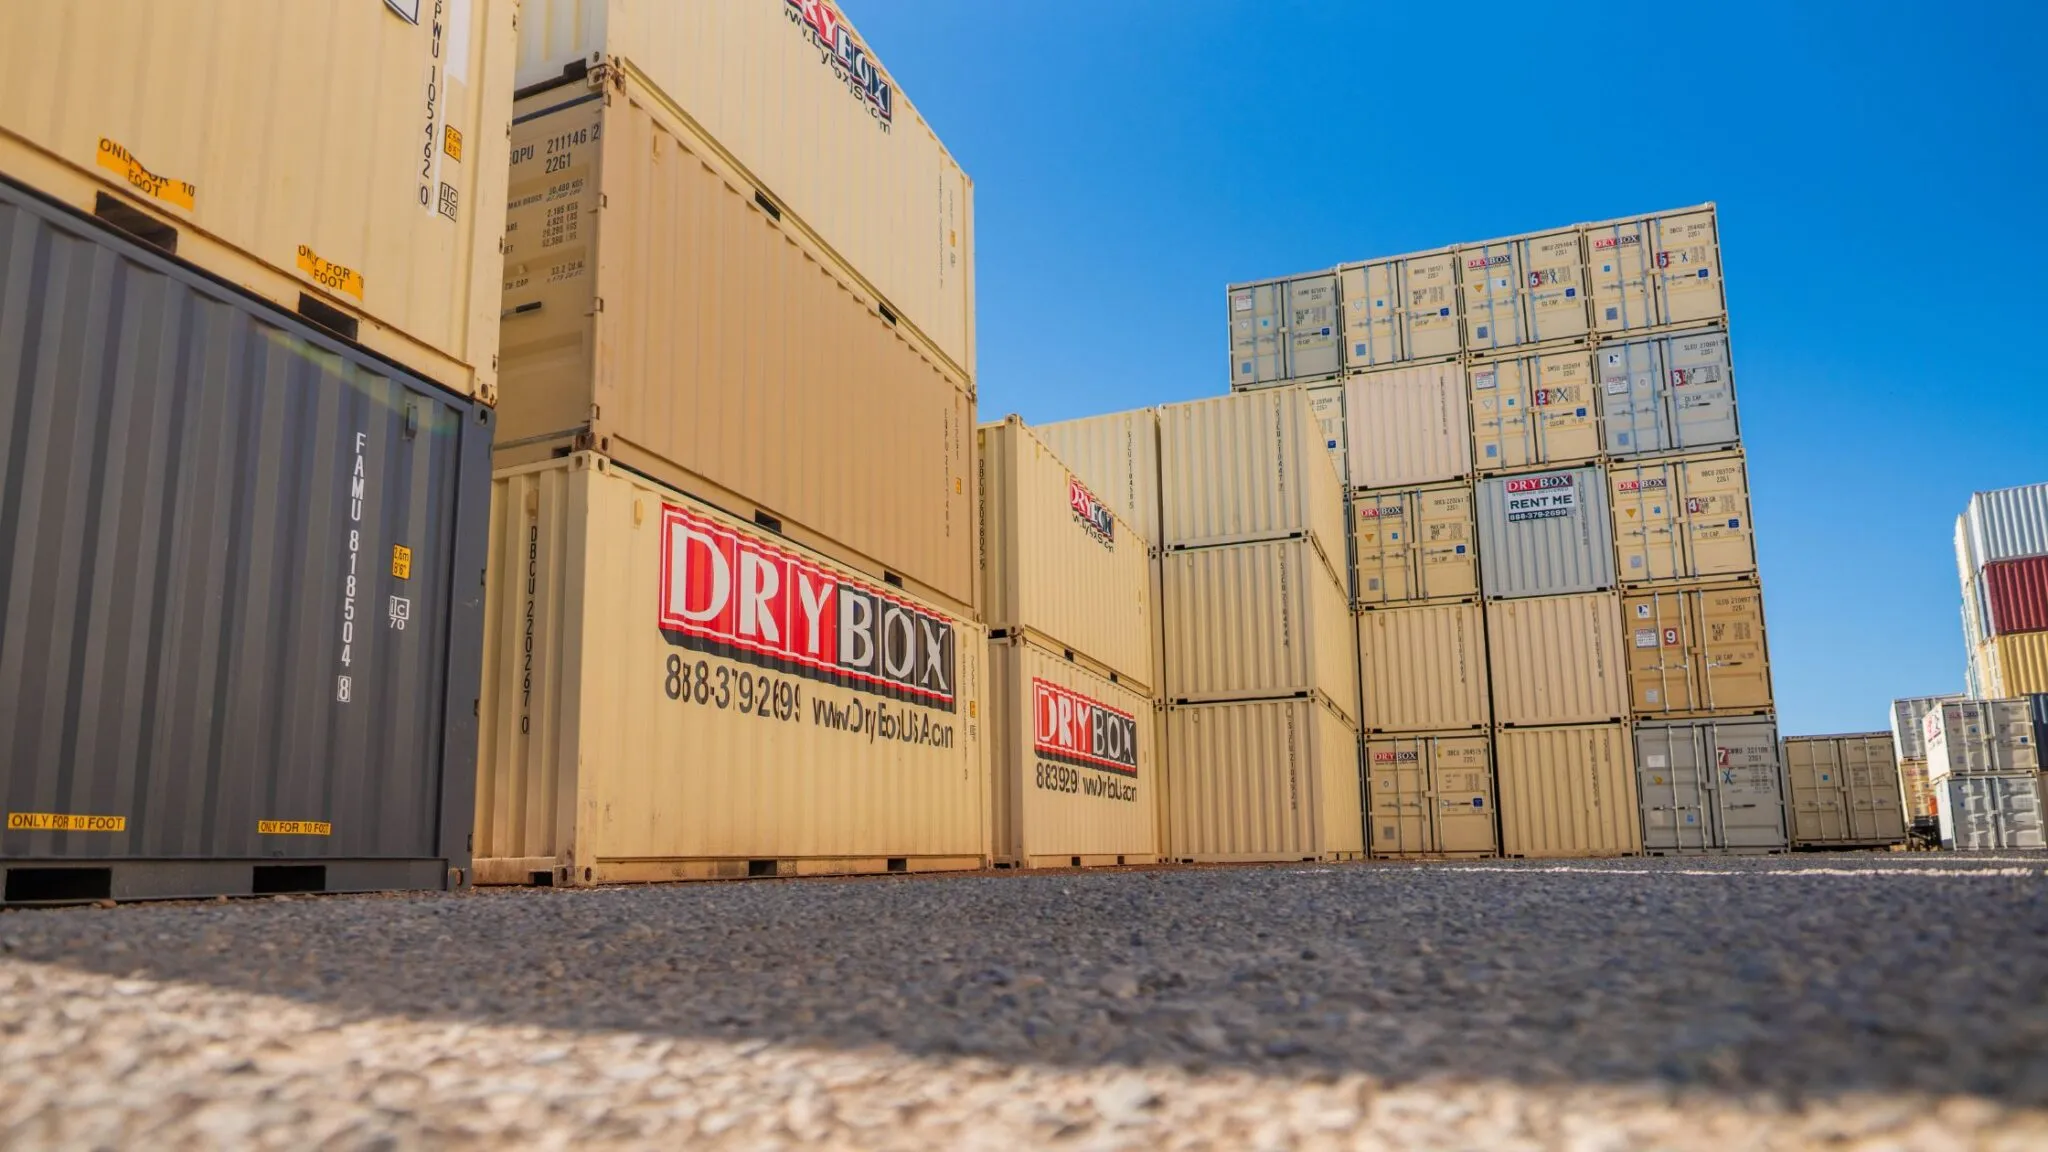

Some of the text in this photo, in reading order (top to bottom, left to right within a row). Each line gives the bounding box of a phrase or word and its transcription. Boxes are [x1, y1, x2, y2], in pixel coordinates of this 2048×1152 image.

[420, 0, 442, 205] PWU 105462 0
[509, 122, 601, 167] QPU 211146 2
[100, 138, 134, 165] ONLY
[181, 182, 196, 197] 10
[545, 153, 571, 174] 22G1
[128, 168, 161, 197] FOOT
[444, 202, 455, 217] 70
[313, 268, 345, 290] FOOT
[326, 262, 351, 280] FOR
[352, 431, 367, 521] FAMU
[1508, 475, 1570, 491] DRYBOX
[1619, 479, 1665, 490] DRYBOX
[1361, 506, 1402, 517] DRYBOX
[1510, 494, 1573, 509] RENT ME
[1510, 509, 1567, 520] 888-379-2699
[528, 525, 538, 595] DBCU
[341, 529, 359, 667] 818504
[669, 522, 948, 691] DRYBOX
[390, 617, 405, 630] 70
[523, 600, 534, 707] 220267
[1039, 689, 1135, 765] DRYBOX
[1375, 752, 1417, 761] DRYBOX
[12, 814, 123, 829] ONLY FOR 10 FOOT
[279, 822, 299, 832] FOR
[304, 823, 313, 832] 10
